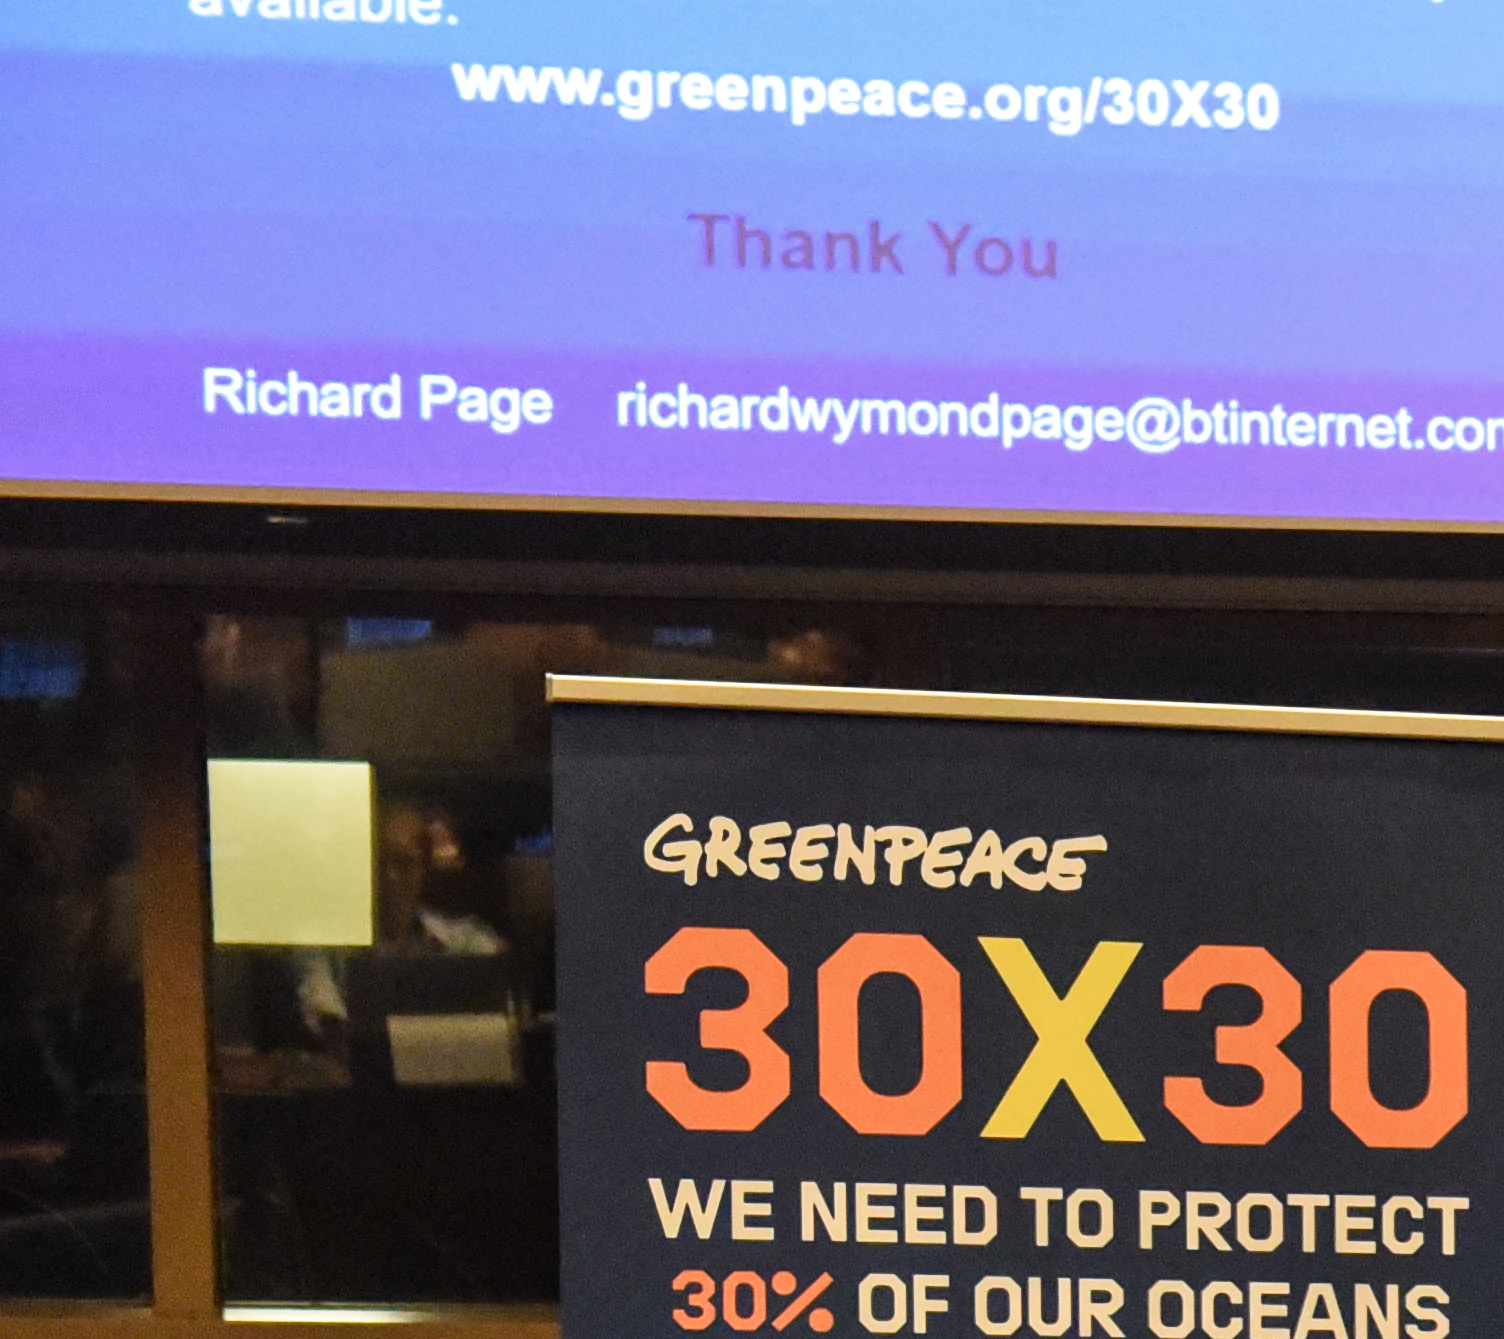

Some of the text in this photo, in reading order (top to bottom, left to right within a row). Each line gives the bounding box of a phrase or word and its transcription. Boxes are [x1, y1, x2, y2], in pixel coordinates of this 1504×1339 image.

[451, 62, 1281, 138] www.greenpeace.org/30X30
[688, 212, 1060, 279] Thank You
[202, 366, 402, 420] Richard
[419, 373, 555, 435] Page
[643, 812, 1108, 893] GREENPEACE
[644, 926, 1469, 1150] 30X30
[648, 1177, 1470, 1257] WE NEED TO PROTECT
[671, 1268, 836, 1334] 30%
[857, 1272, 950, 1335] OF
[974, 1275, 1125, 1339] OUR
